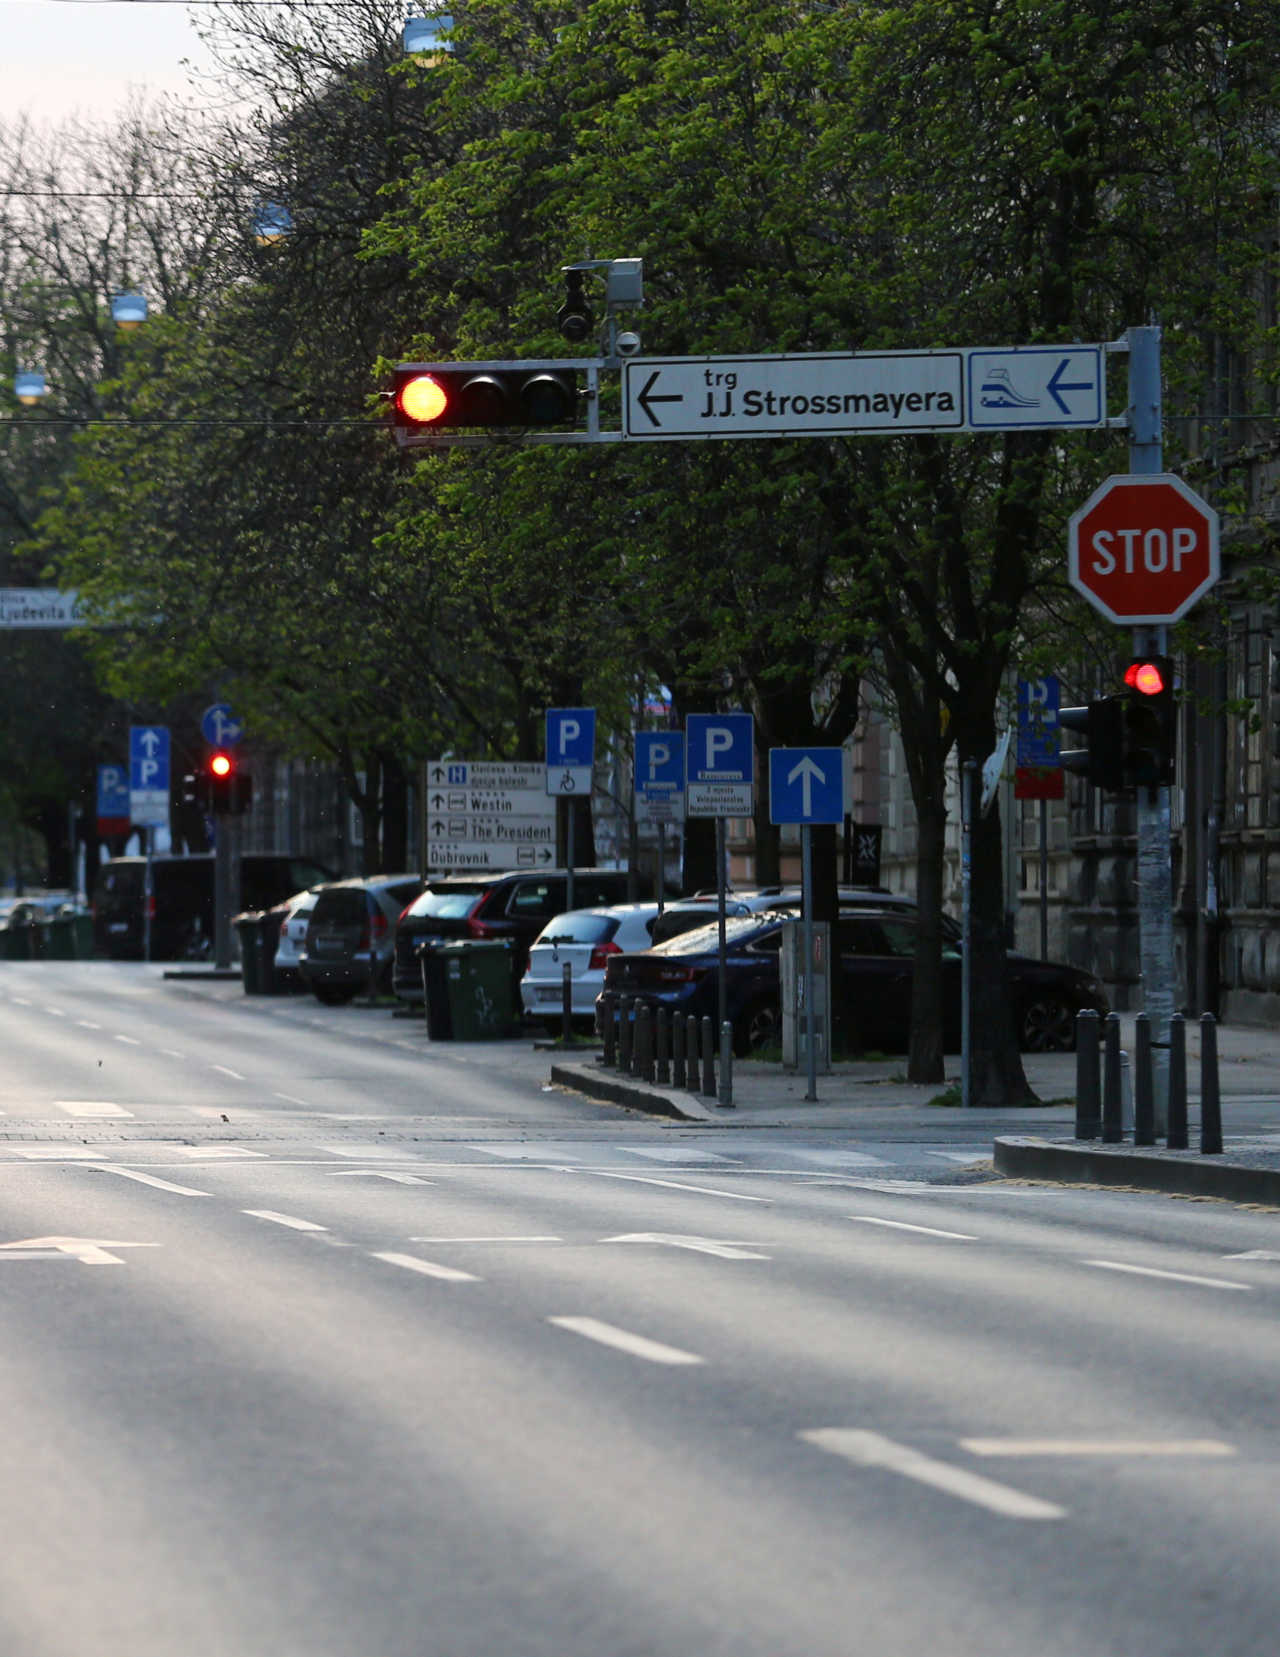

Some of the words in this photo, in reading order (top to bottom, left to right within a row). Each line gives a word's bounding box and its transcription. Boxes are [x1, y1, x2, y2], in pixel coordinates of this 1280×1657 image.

[704, 368, 737, 391] trg
[701, 391, 736, 418] J.J.
[743, 388, 955, 421] Strossmayera
[1091, 526, 1198, 576] STOP
[0, 604, 65, 623] Ljudevita
[560, 719, 580, 755] P
[706, 727, 734, 769] P
[141, 759, 159, 784] P
[649, 743, 670, 780] P
[471, 798, 512, 812] Westin
[472, 825, 493, 838] The
[497, 825, 551, 841] President
[431, 850, 490, 865] Dubrovnik
